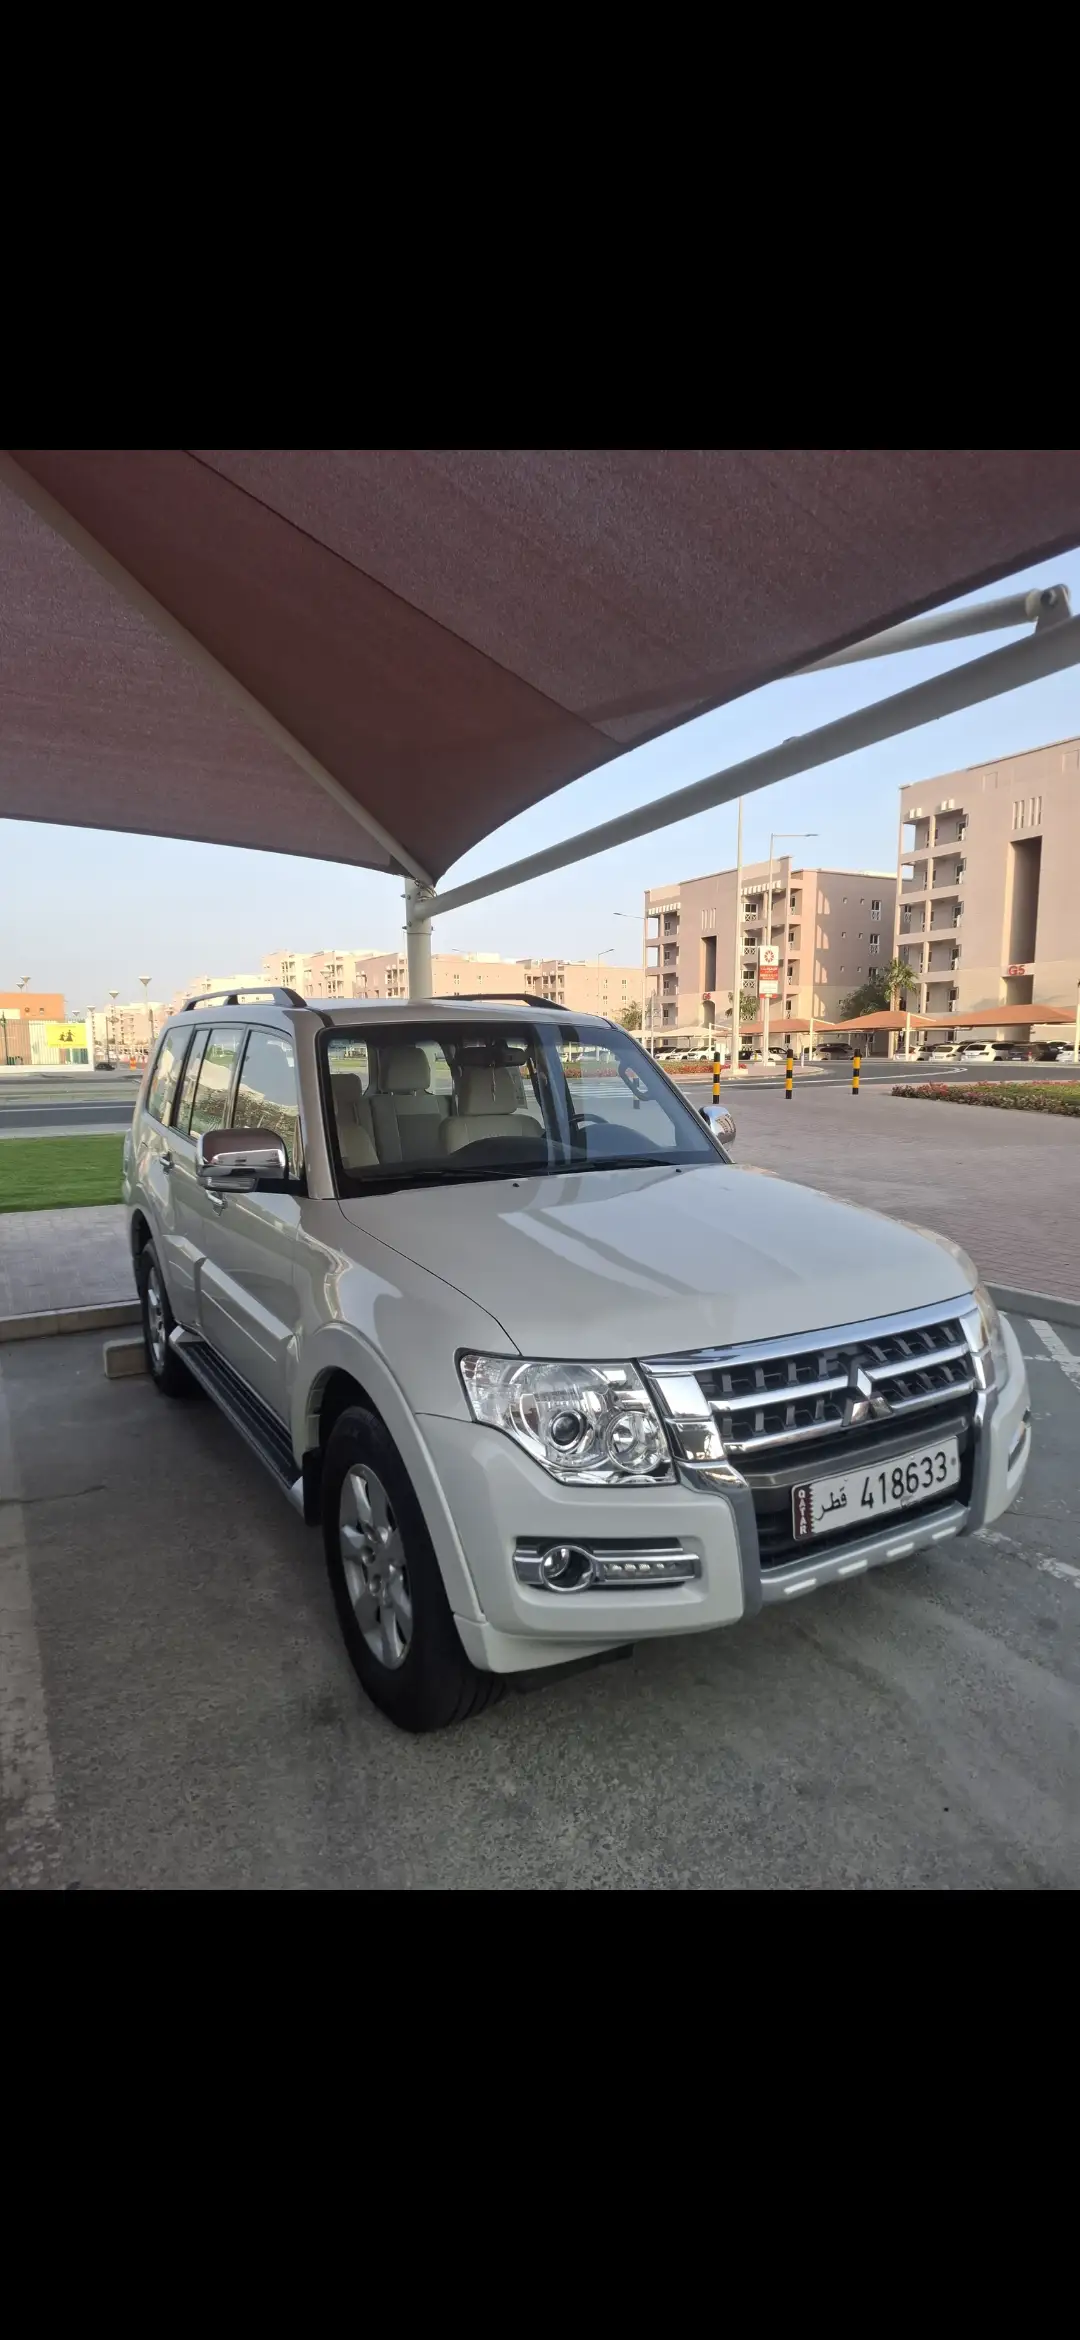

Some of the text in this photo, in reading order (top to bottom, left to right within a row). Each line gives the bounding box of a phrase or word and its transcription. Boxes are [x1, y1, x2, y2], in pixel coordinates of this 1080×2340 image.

[1008, 964, 1026, 976] G5
[860, 1451, 948, 1510] 418633
[798, 1489, 808, 1535] QATAR
[814, 1486, 848, 1521] قطر
